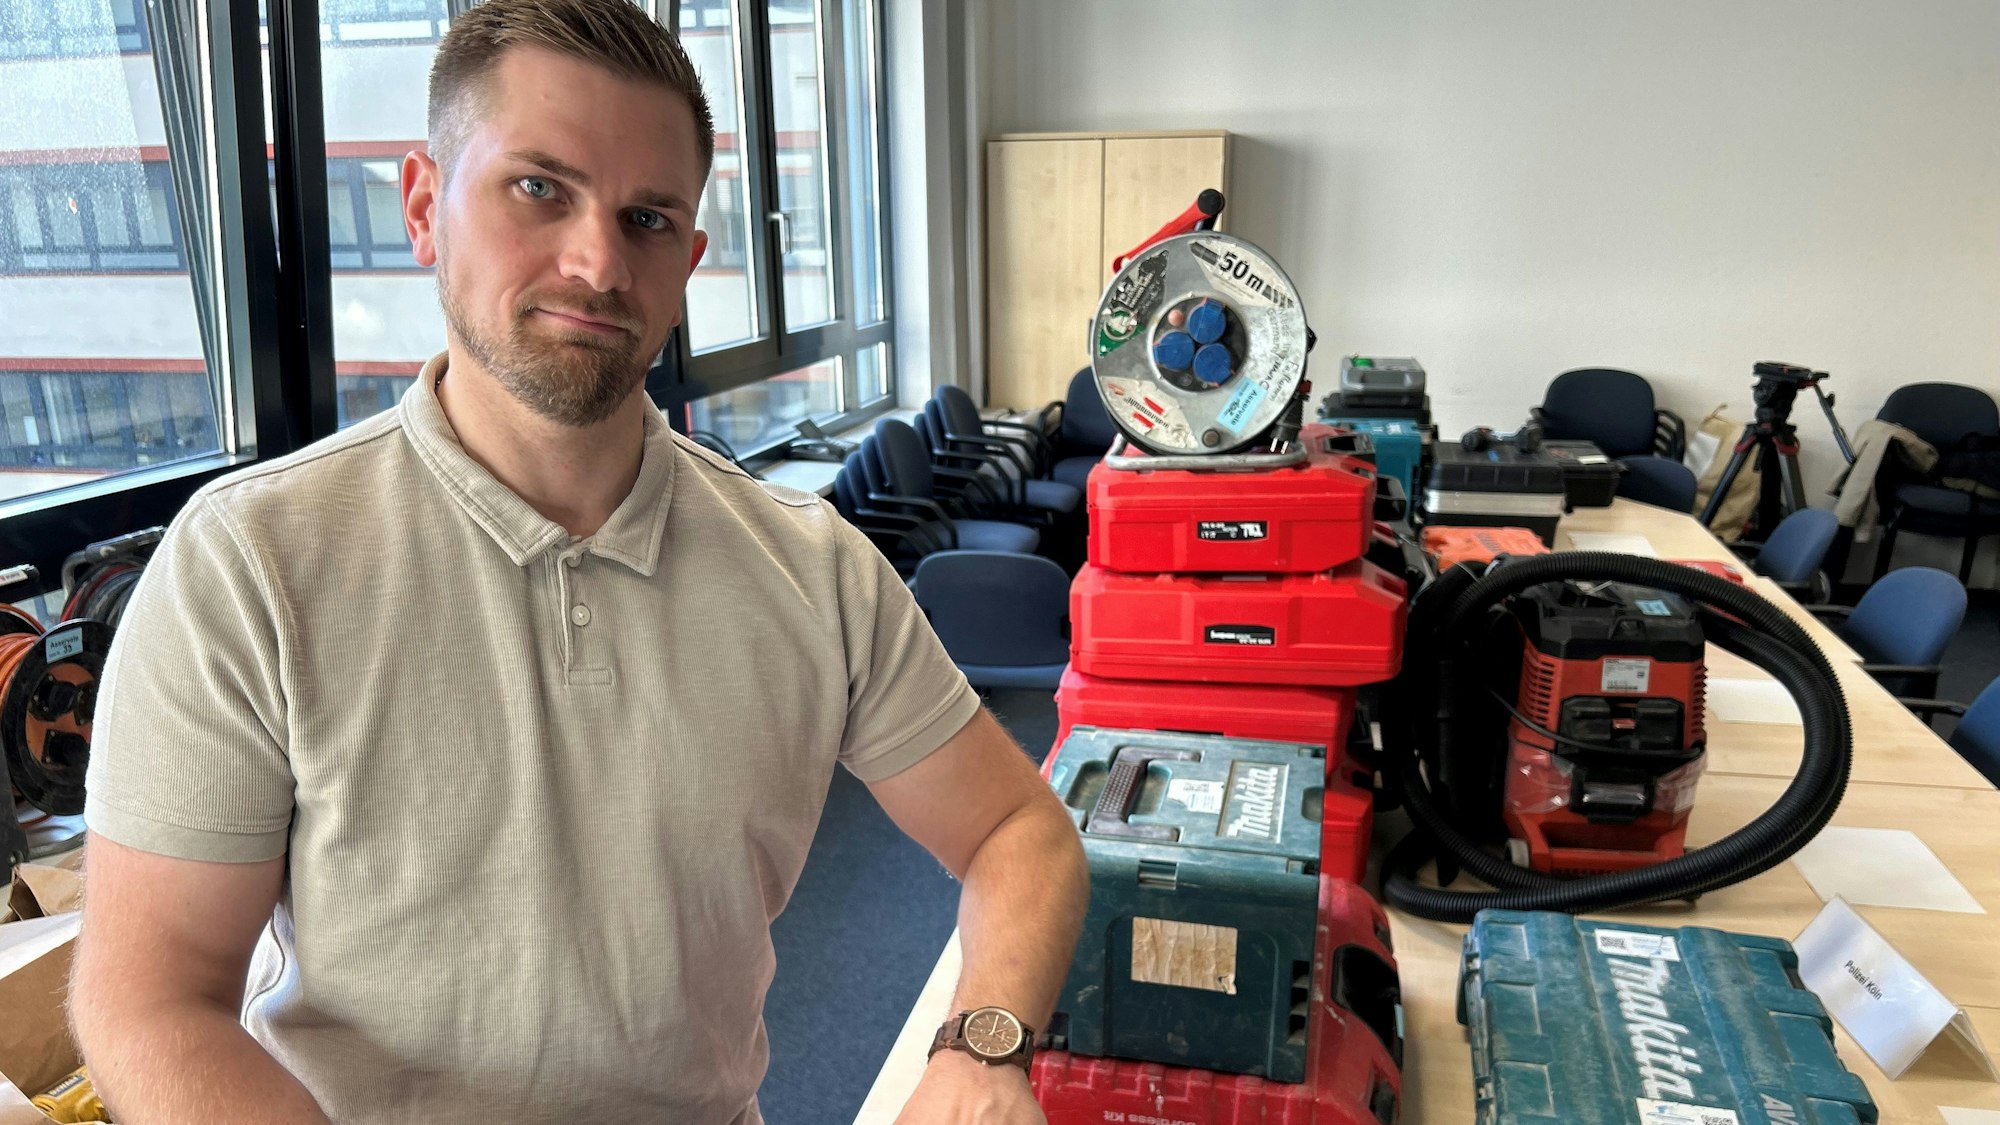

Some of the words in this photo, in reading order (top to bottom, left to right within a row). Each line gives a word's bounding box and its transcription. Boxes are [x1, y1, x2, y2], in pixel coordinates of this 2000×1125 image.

[1219, 251, 1249, 279] 50
[1245, 273, 1264, 291] m
[1843, 960, 1870, 985] Polizei
[1865, 980, 1883, 1000] Köln
[1103, 1110, 1125, 1122] Kit
